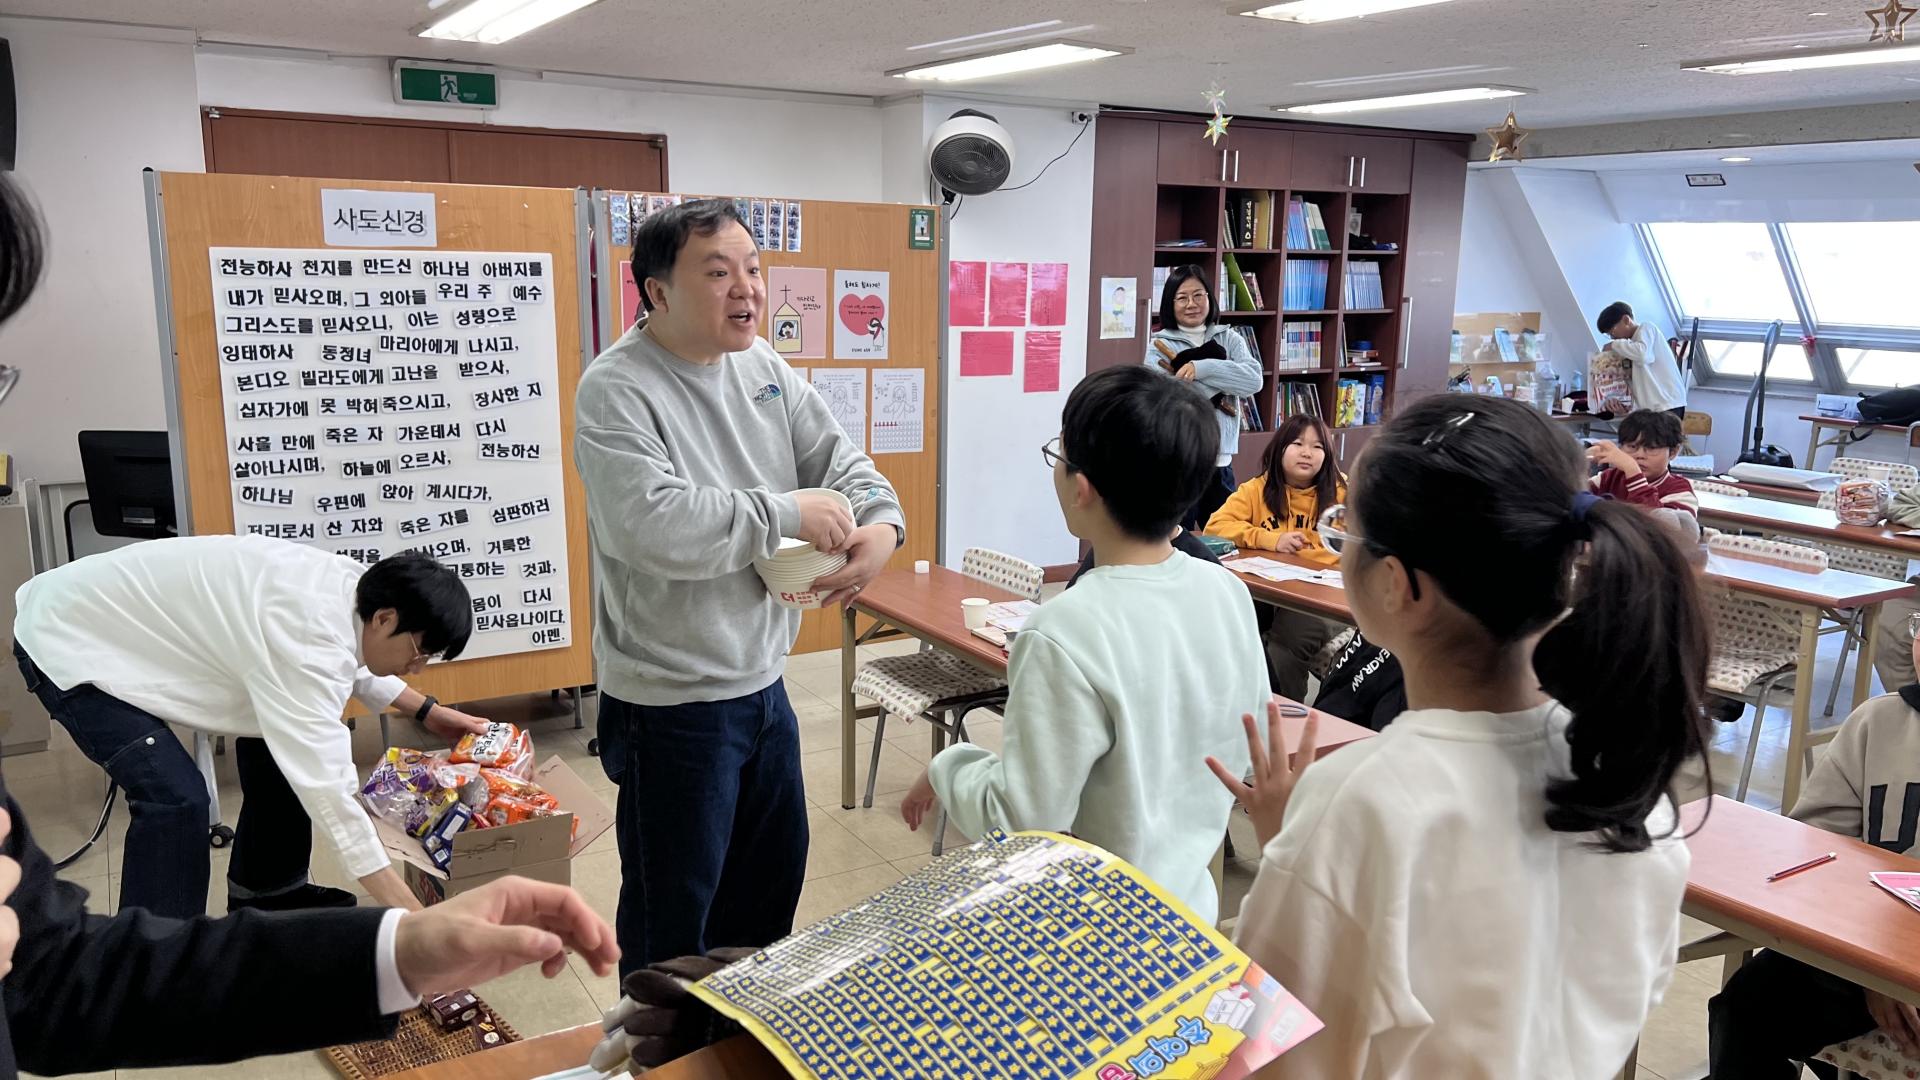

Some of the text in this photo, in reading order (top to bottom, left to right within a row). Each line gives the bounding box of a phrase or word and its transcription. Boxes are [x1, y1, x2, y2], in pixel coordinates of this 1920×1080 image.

[333, 207, 426, 235] 사도신경
[220, 258, 542, 278] 전능하사 천지를 만드신 하나님 아버지를
[227, 283, 542, 308] 내가 믿사오며, 그 외아들 우리 주 예수
[226, 306, 517, 334] 그리스도를 믿사오니, 이는 성령으로
[222, 335, 519, 364] 잉태하사 동정녀 마리아에게 나시고,
[236, 359, 510, 392] 본디오 빌라도에게 고난을 받으사,
[239, 381, 542, 419] 십자가에 못 박혀 죽으시고, 장사한 지
[237, 418, 507, 453] 사흘 만에 죽은 자 가운데서 다시
[234, 443, 540, 479] 살아나시며, 하늘에 오르사, 전능하신
[242, 483, 493, 513] 하나님 우편에 앉아 계시다가,
[326, 520, 343, 536] 산
[351, 517, 384, 534] 자와
[400, 517, 431, 535] 죽은
[438, 508, 469, 527] 자를
[492, 499, 550, 523] 심판하러
[487, 535, 531, 555] 거룩한
[523, 560, 557, 578] 것과,
[472, 587, 552, 613] 몸이 다시
[476, 610, 565, 631] 믿사옵나이다.
[531, 628, 565, 644] 아멘.
